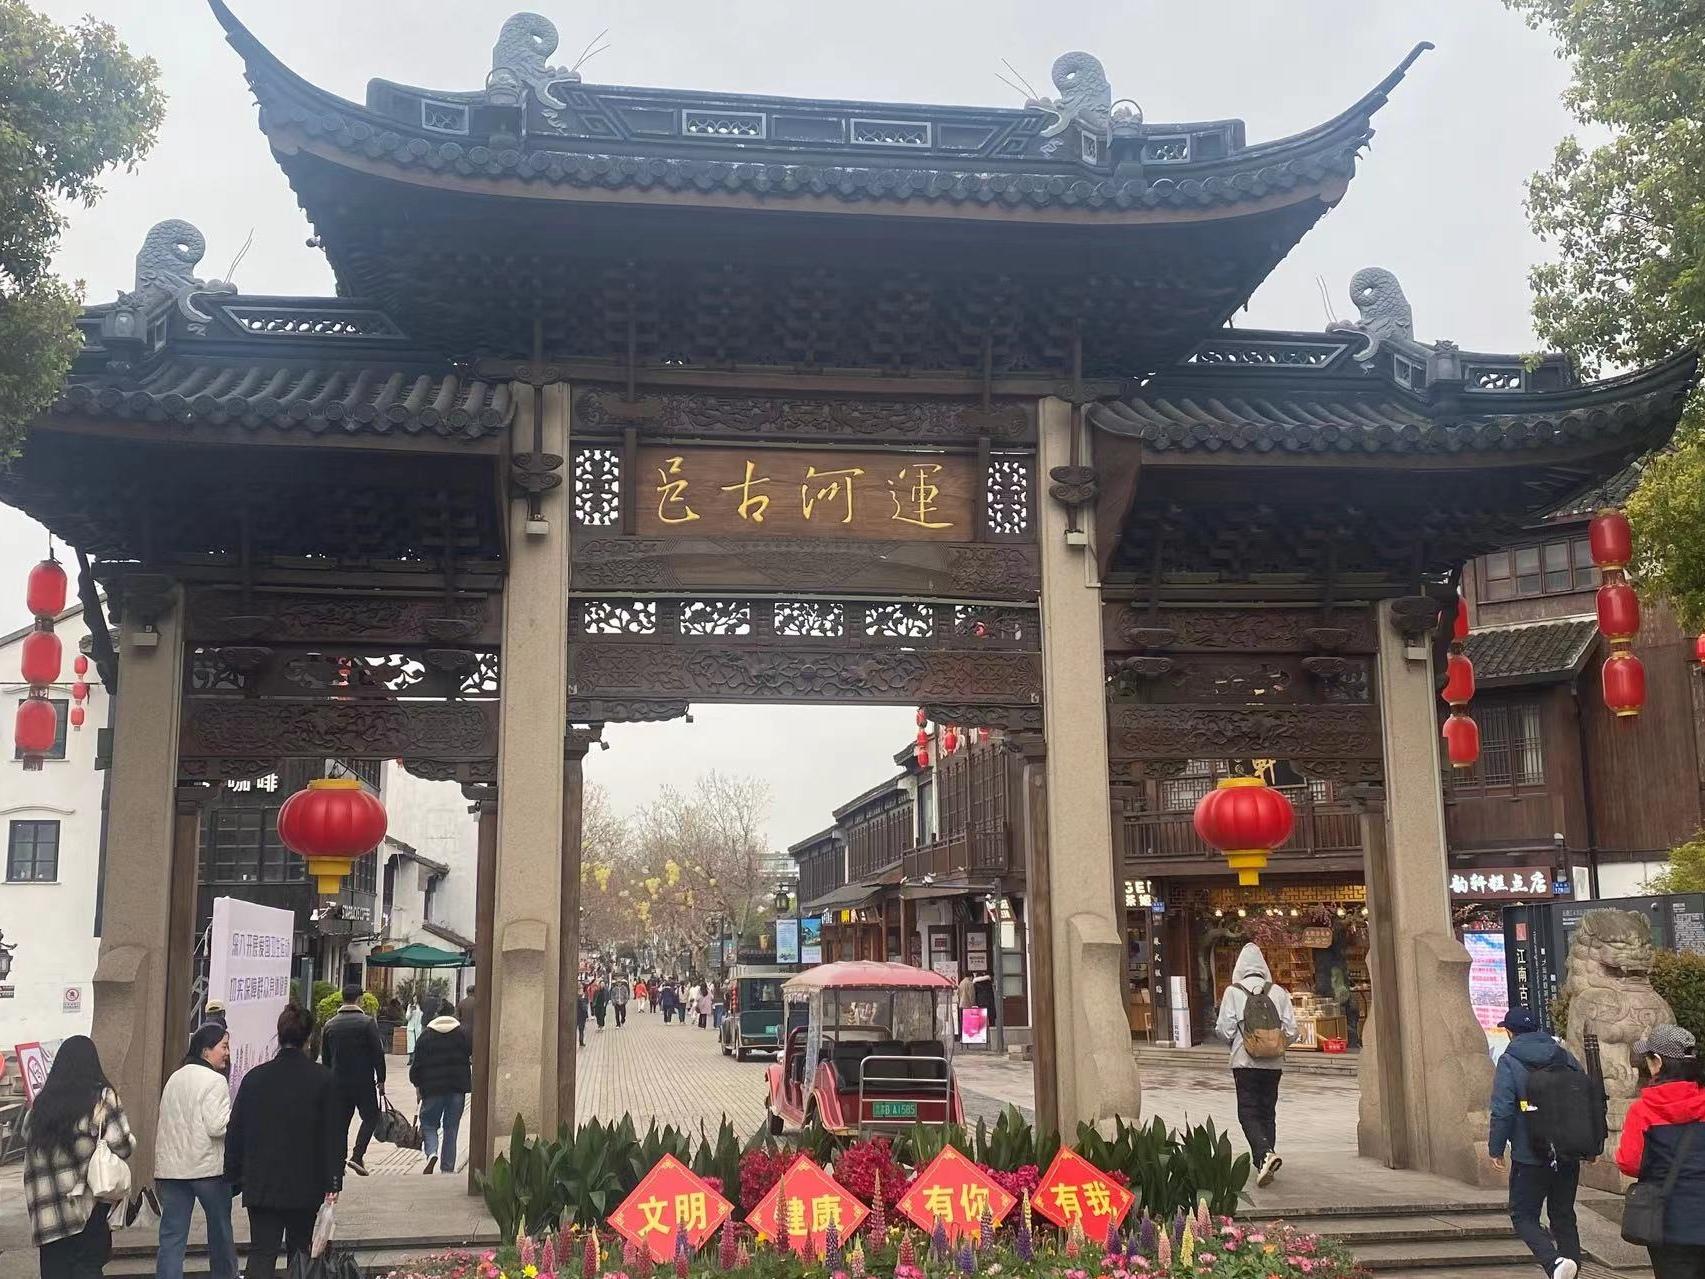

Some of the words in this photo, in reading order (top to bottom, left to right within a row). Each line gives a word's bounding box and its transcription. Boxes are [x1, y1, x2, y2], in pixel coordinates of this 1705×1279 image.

[203, 773, 279, 793] 咖啡
[637, 1192, 707, 1237] 文明
[773, 1194, 844, 1236] 健康
[923, 1183, 993, 1223] 有你
[1051, 1180, 1118, 1219] 有我
